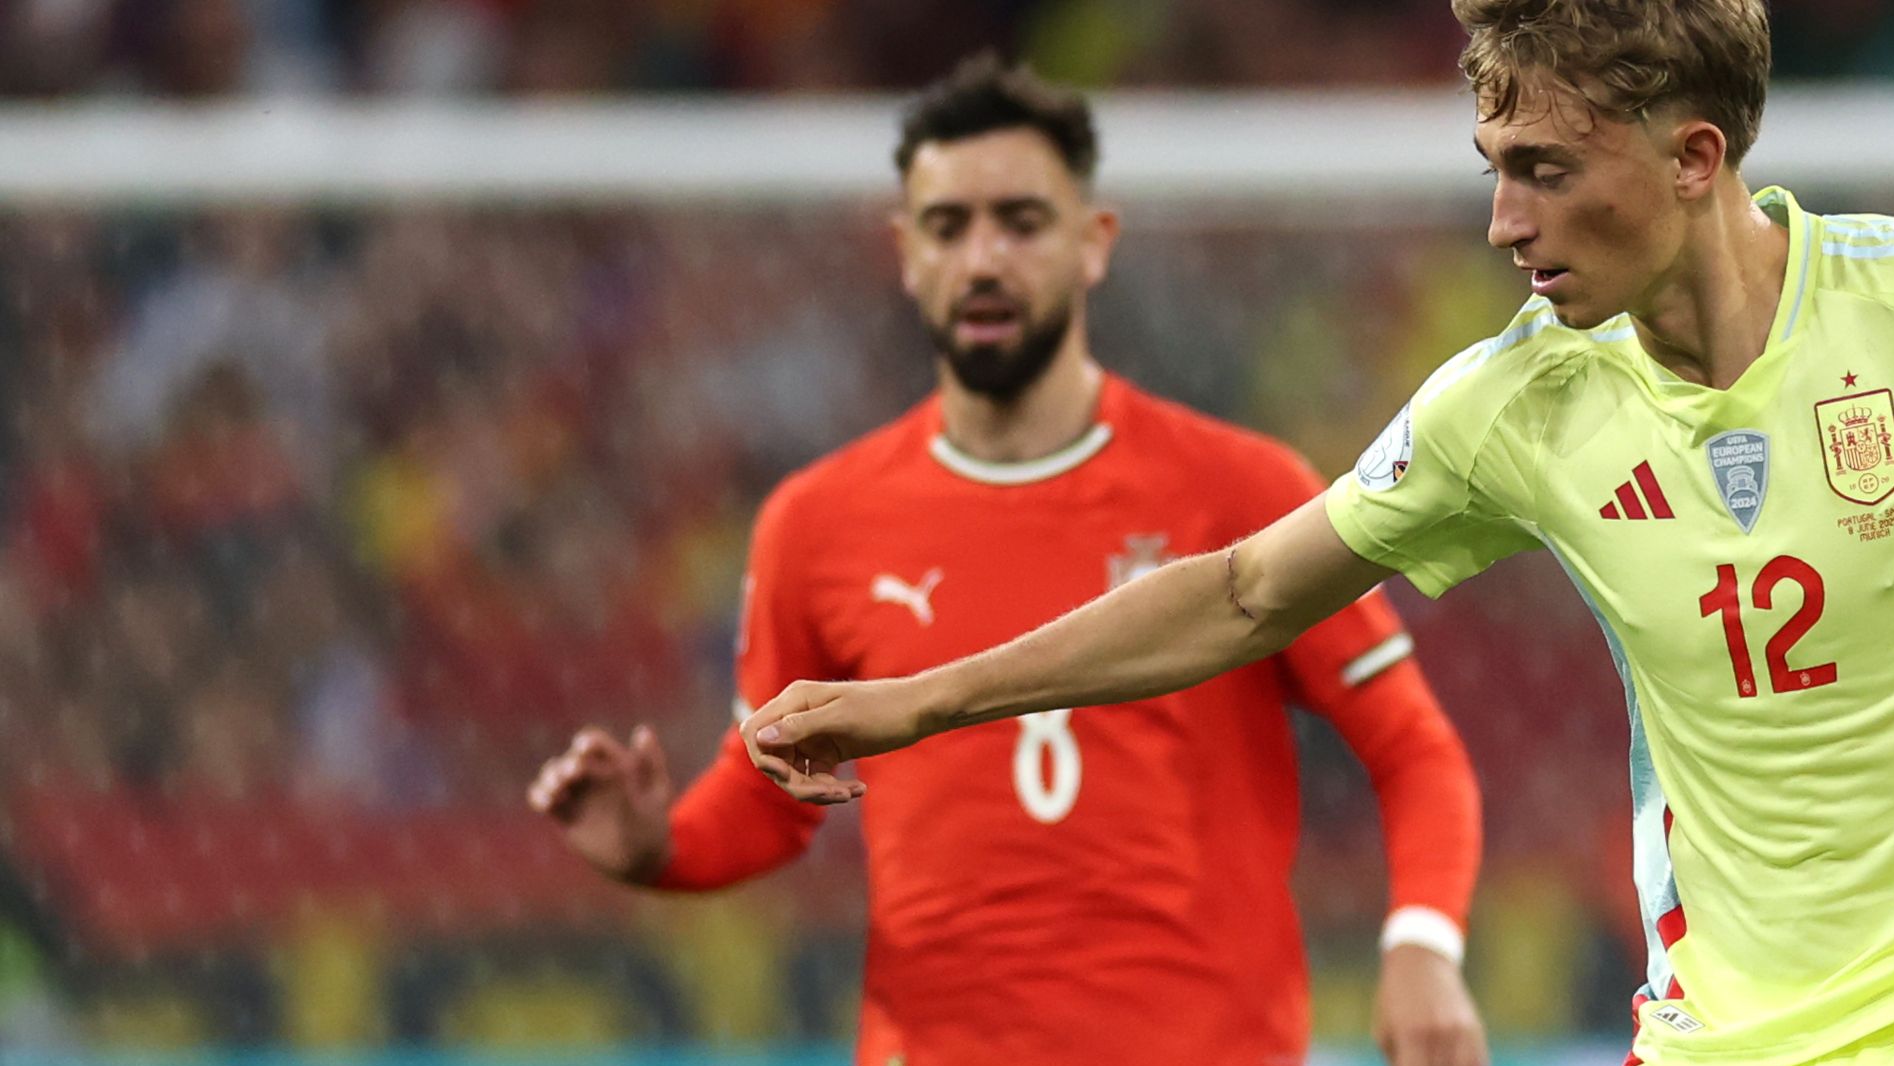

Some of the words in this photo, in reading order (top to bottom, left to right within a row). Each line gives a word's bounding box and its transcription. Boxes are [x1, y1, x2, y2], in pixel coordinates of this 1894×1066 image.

[1711, 442, 1763, 458] EUROPEAN
[1713, 453, 1764, 468] CHAMPIONS
[1731, 496, 1757, 509] 2024
[1837, 513, 1877, 528] PORTUGAL
[1860, 527, 1891, 542] MUNICH
[1698, 554, 1838, 698] 12
